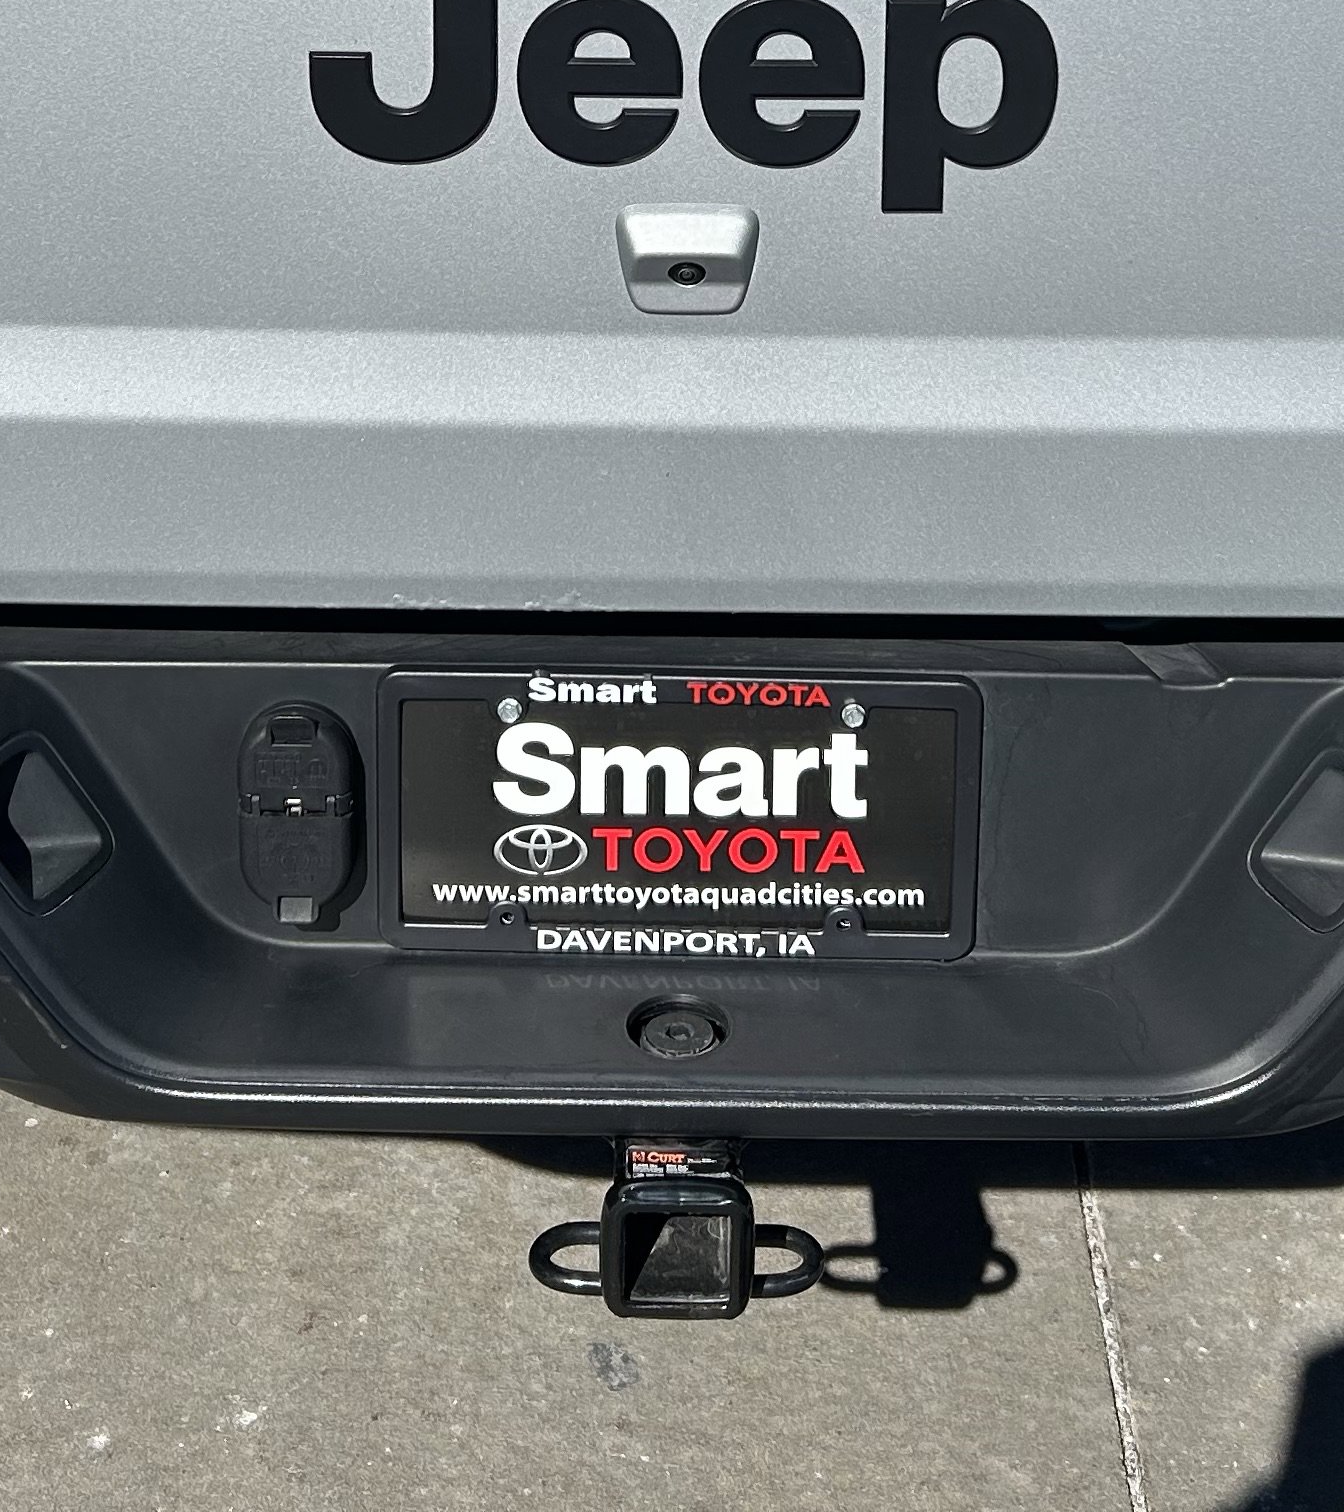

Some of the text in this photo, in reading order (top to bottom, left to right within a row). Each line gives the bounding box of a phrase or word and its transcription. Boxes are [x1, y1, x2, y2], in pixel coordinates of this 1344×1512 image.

[527, 676, 832, 707] Smart TOYOTA
[492, 722, 869, 819] Smart
[592, 827, 866, 875] TOYOTA
[432, 881, 925, 910] www.smarttoyotaquadcities.com
[536, 929, 816, 957] DAVENPORT, IA
